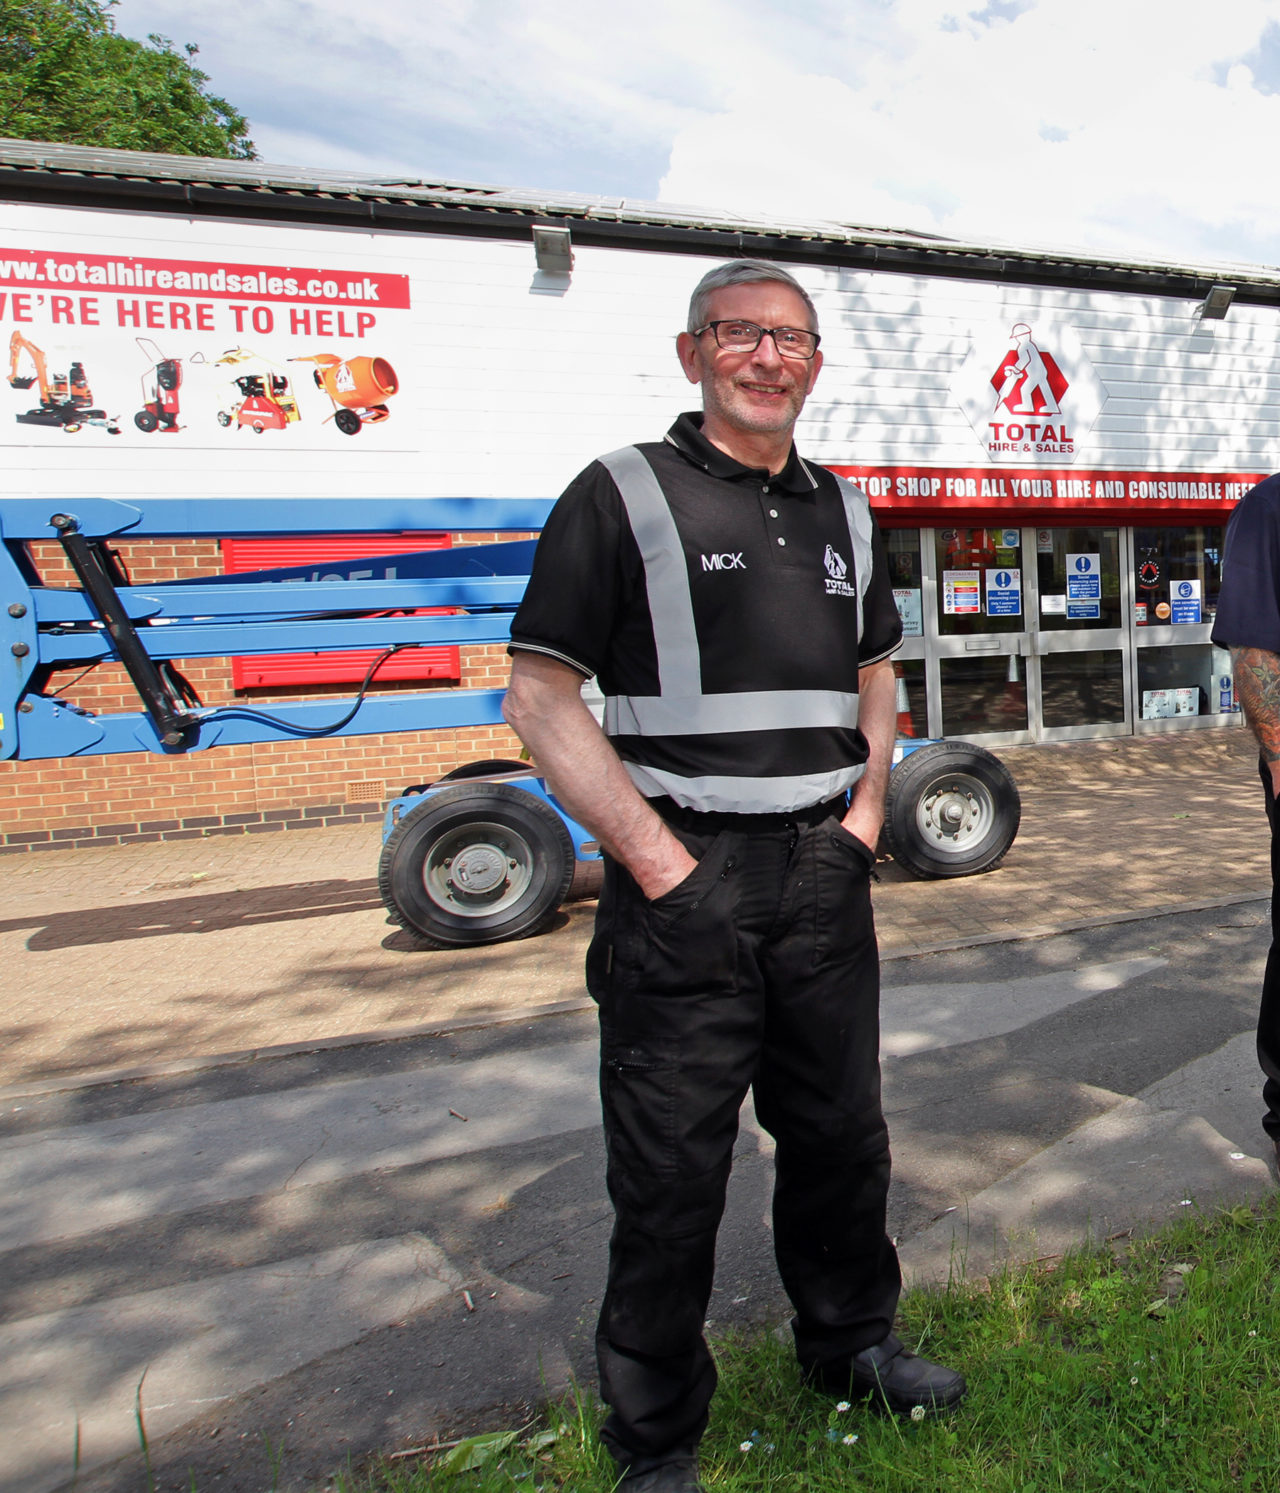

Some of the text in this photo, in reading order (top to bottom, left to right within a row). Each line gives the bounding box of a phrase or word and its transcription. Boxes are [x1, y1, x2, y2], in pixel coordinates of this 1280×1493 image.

[116, 298, 216, 331] HERE
[229, 304, 274, 334] TO
[289, 308, 376, 338] HELP
[988, 422, 1074, 443] TOTAL
[988, 442, 1074, 453] HIRE & SALES
[896, 477, 941, 497] SHOP
[945, 478, 977, 498] FOR
[980, 478, 1007, 498] ALL
[1010, 478, 1053, 499] YOUR
[1056, 479, 1092, 499] HIRE
[1095, 480, 1125, 499] AND
[1128, 480, 1222, 500] CONSUMABLE
[701, 552, 747, 572] MICK
[825, 579, 854, 591] TOTAL
